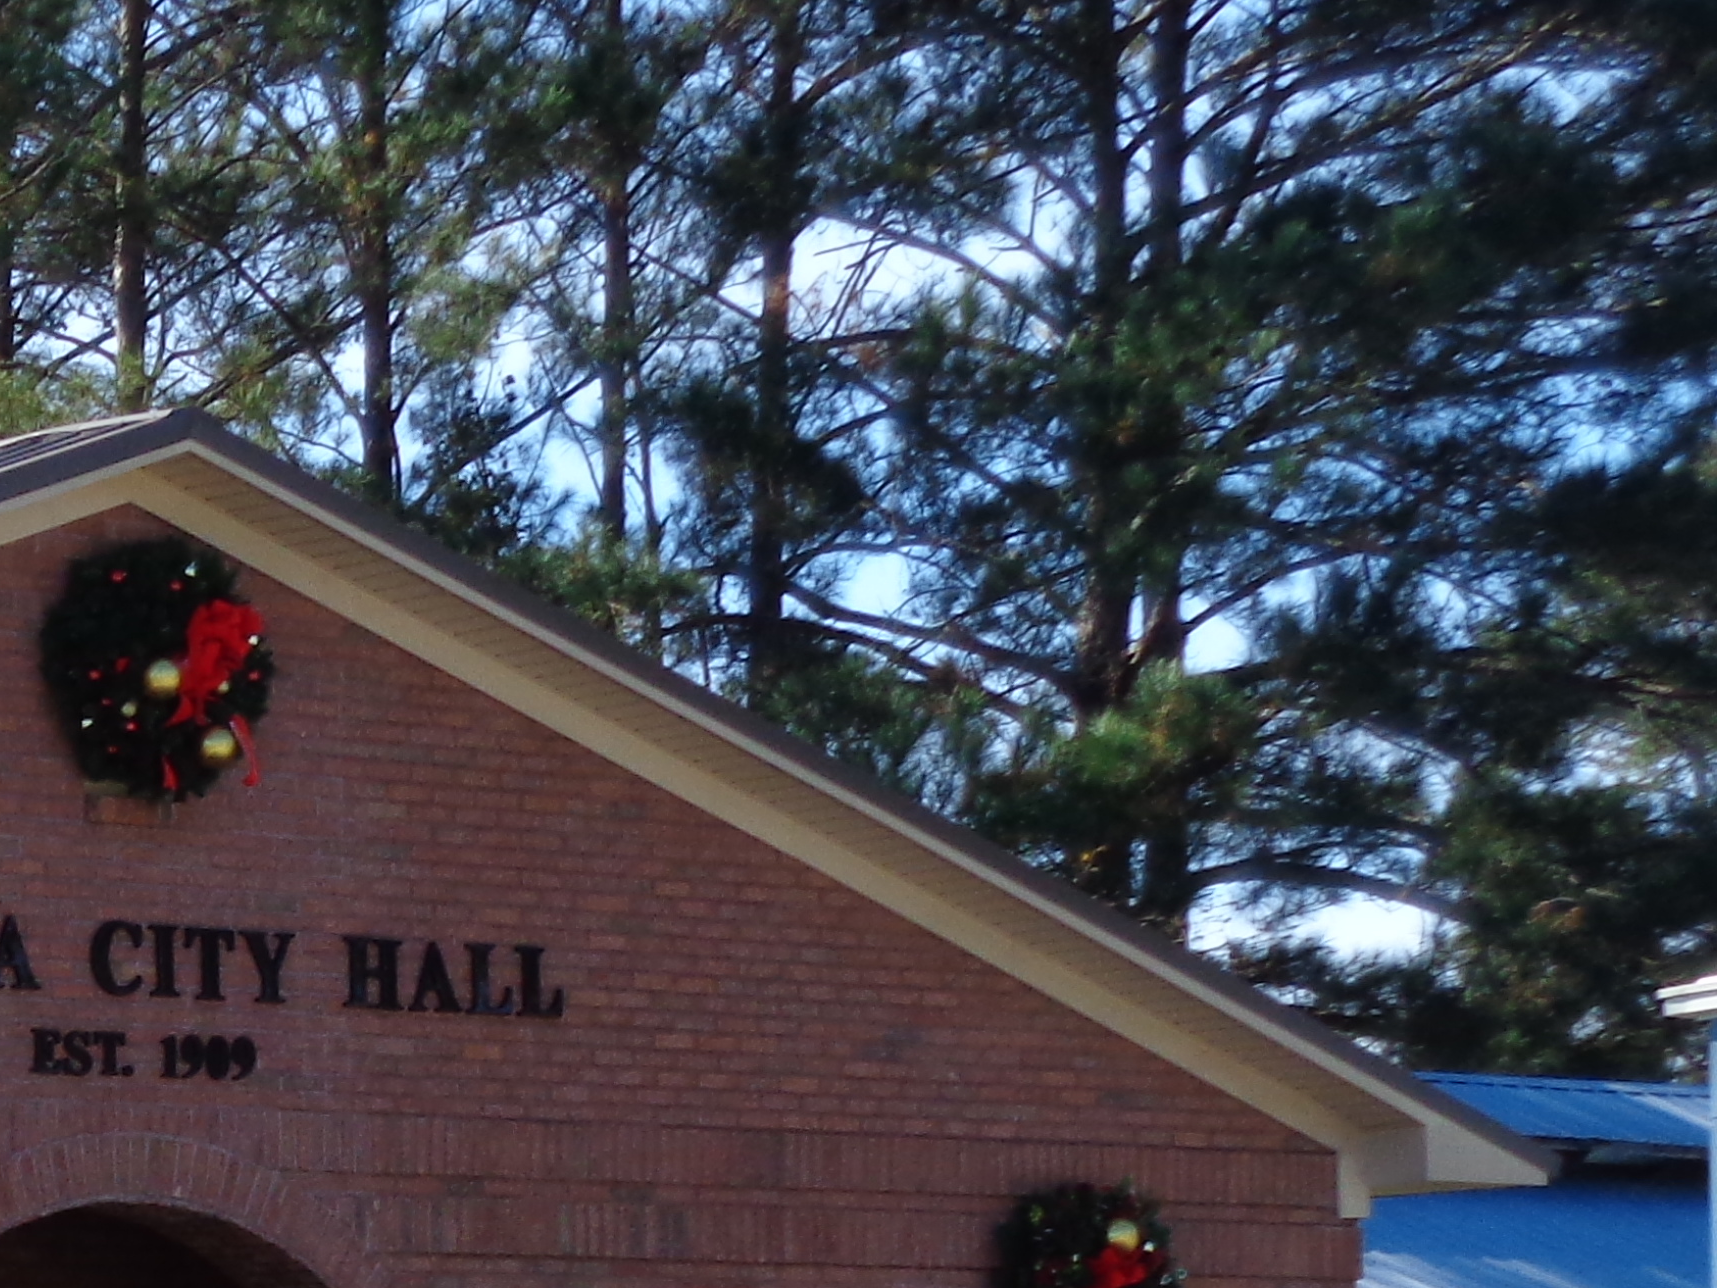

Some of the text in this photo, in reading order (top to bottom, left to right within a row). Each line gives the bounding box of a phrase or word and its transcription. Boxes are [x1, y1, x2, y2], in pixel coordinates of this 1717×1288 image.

[89, 919, 296, 1005] CITY
[342, 933, 564, 1018] HALL
[28, 1028, 257, 1081] EST. 1909
